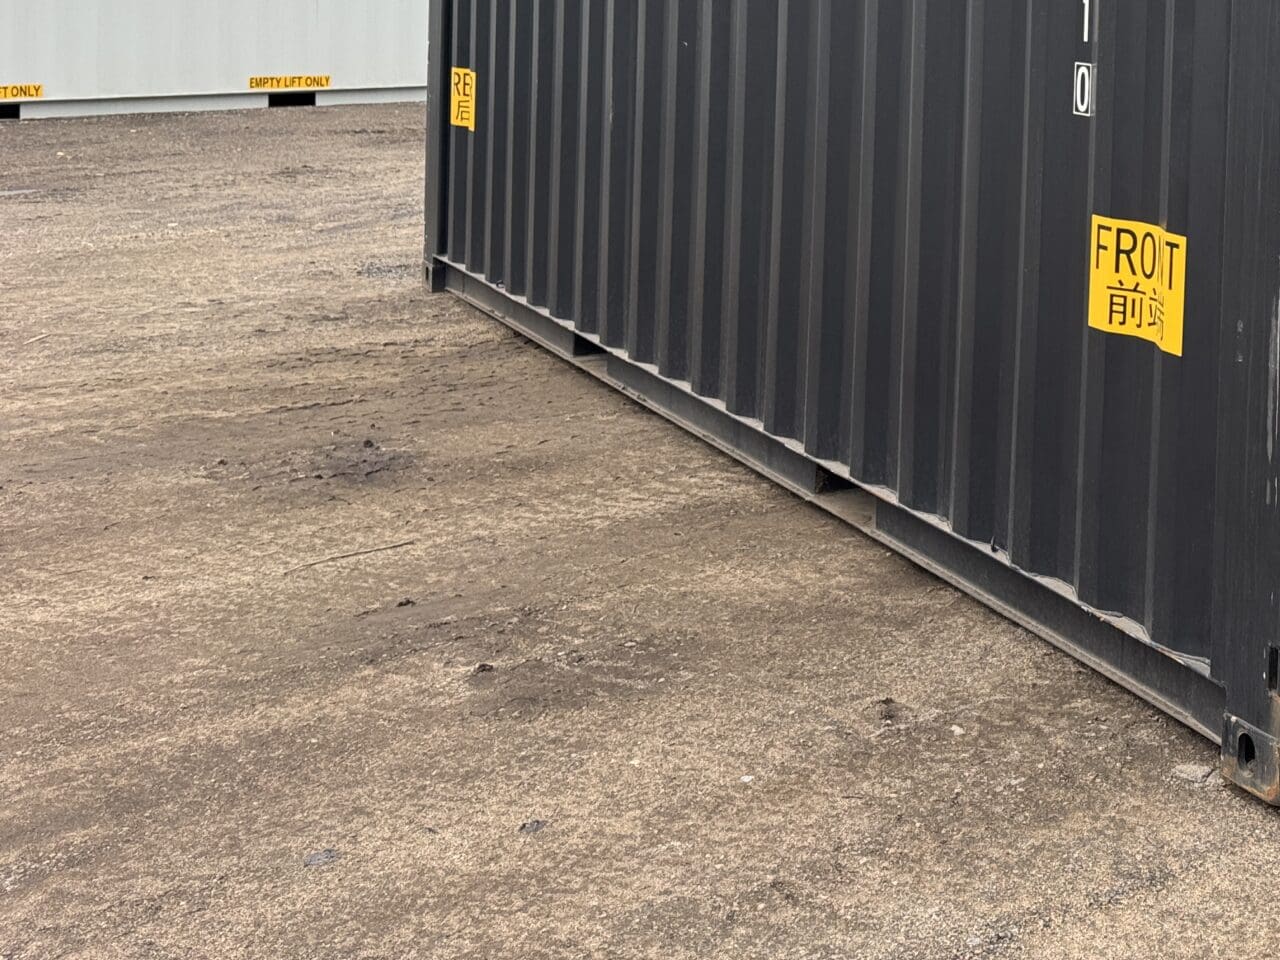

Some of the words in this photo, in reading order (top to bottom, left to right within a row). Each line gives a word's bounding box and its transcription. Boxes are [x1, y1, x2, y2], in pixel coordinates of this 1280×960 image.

[249, 76, 282, 89] EMPTY
[284, 76, 304, 88] LIFT
[305, 75, 330, 88] ONLY
[11, 85, 41, 98] ONLY
